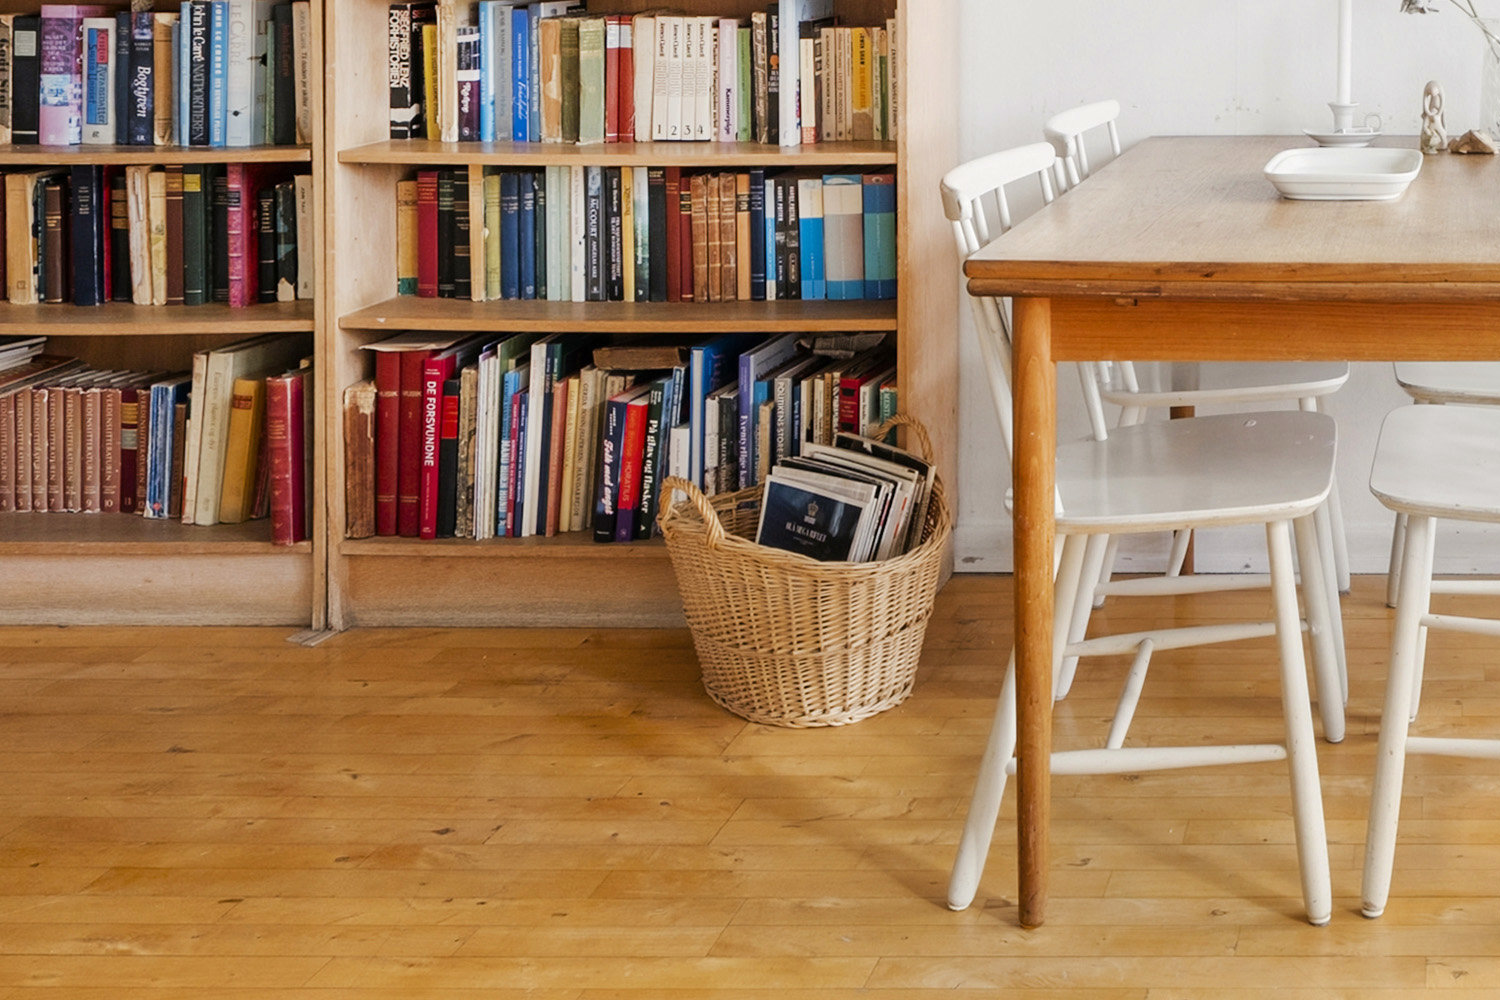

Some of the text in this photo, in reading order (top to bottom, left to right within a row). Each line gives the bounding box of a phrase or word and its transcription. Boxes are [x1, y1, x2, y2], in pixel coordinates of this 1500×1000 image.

[214, 4, 222, 28] JOHN
[230, 4, 241, 18] LE
[192, 4, 206, 141] John le Carré NATPORTIEREN
[390, 10, 399, 88] FORHISTORIEN
[400, 10, 409, 88] SIEGFRIED LENZ
[133, 66, 151, 117] Bogtyven
[657, 124, 662, 134] 1
[670, 125, 677, 135] 2
[684, 125, 691, 135] 3
[697, 124, 703, 134] 4
[424, 381, 437, 467] DE FORSVUNDNE
[739, 415, 749, 469] Eventyrlige
[776, 381, 785, 453] POLITIKENS STORE
[501, 439, 511, 464] MAND
[601, 439, 614, 515] Folk med angst
[641, 419, 658, 513] På glas og flasker
[622, 461, 633, 502] HORATIUS
